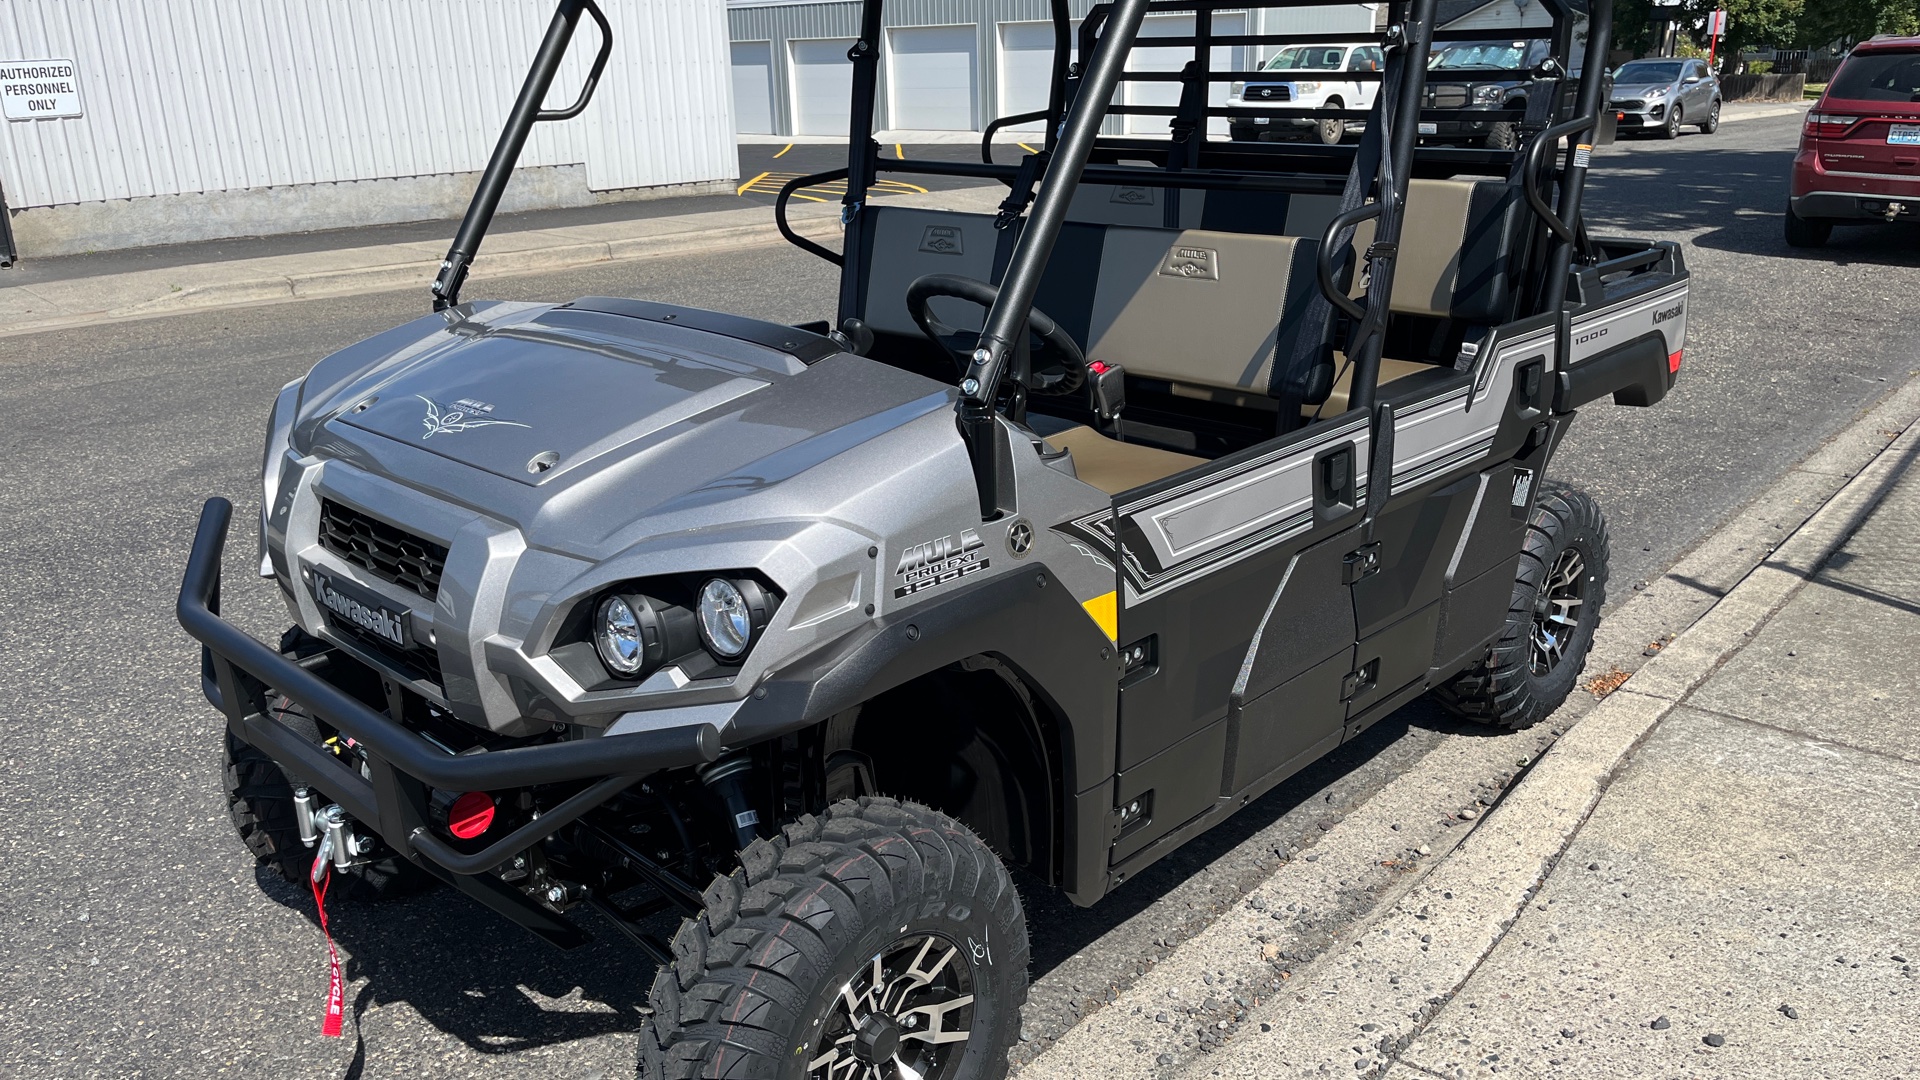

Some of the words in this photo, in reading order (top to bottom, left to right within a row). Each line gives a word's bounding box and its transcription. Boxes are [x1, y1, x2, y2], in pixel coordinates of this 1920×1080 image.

[0, 66, 72, 80] AUTHORIZED
[4, 82, 74, 96] PERSONNEL
[28, 98, 56, 111] ONLY
[1652, 301, 1684, 326] Kawasaki
[1575, 328, 1608, 345] 1000
[895, 527, 985, 577] MULE
[902, 561, 983, 595] 1000
[903, 550, 979, 584] PRO-FXT
[314, 573, 404, 645] Kawasaki
[330, 966, 341, 1016] CYCLE
